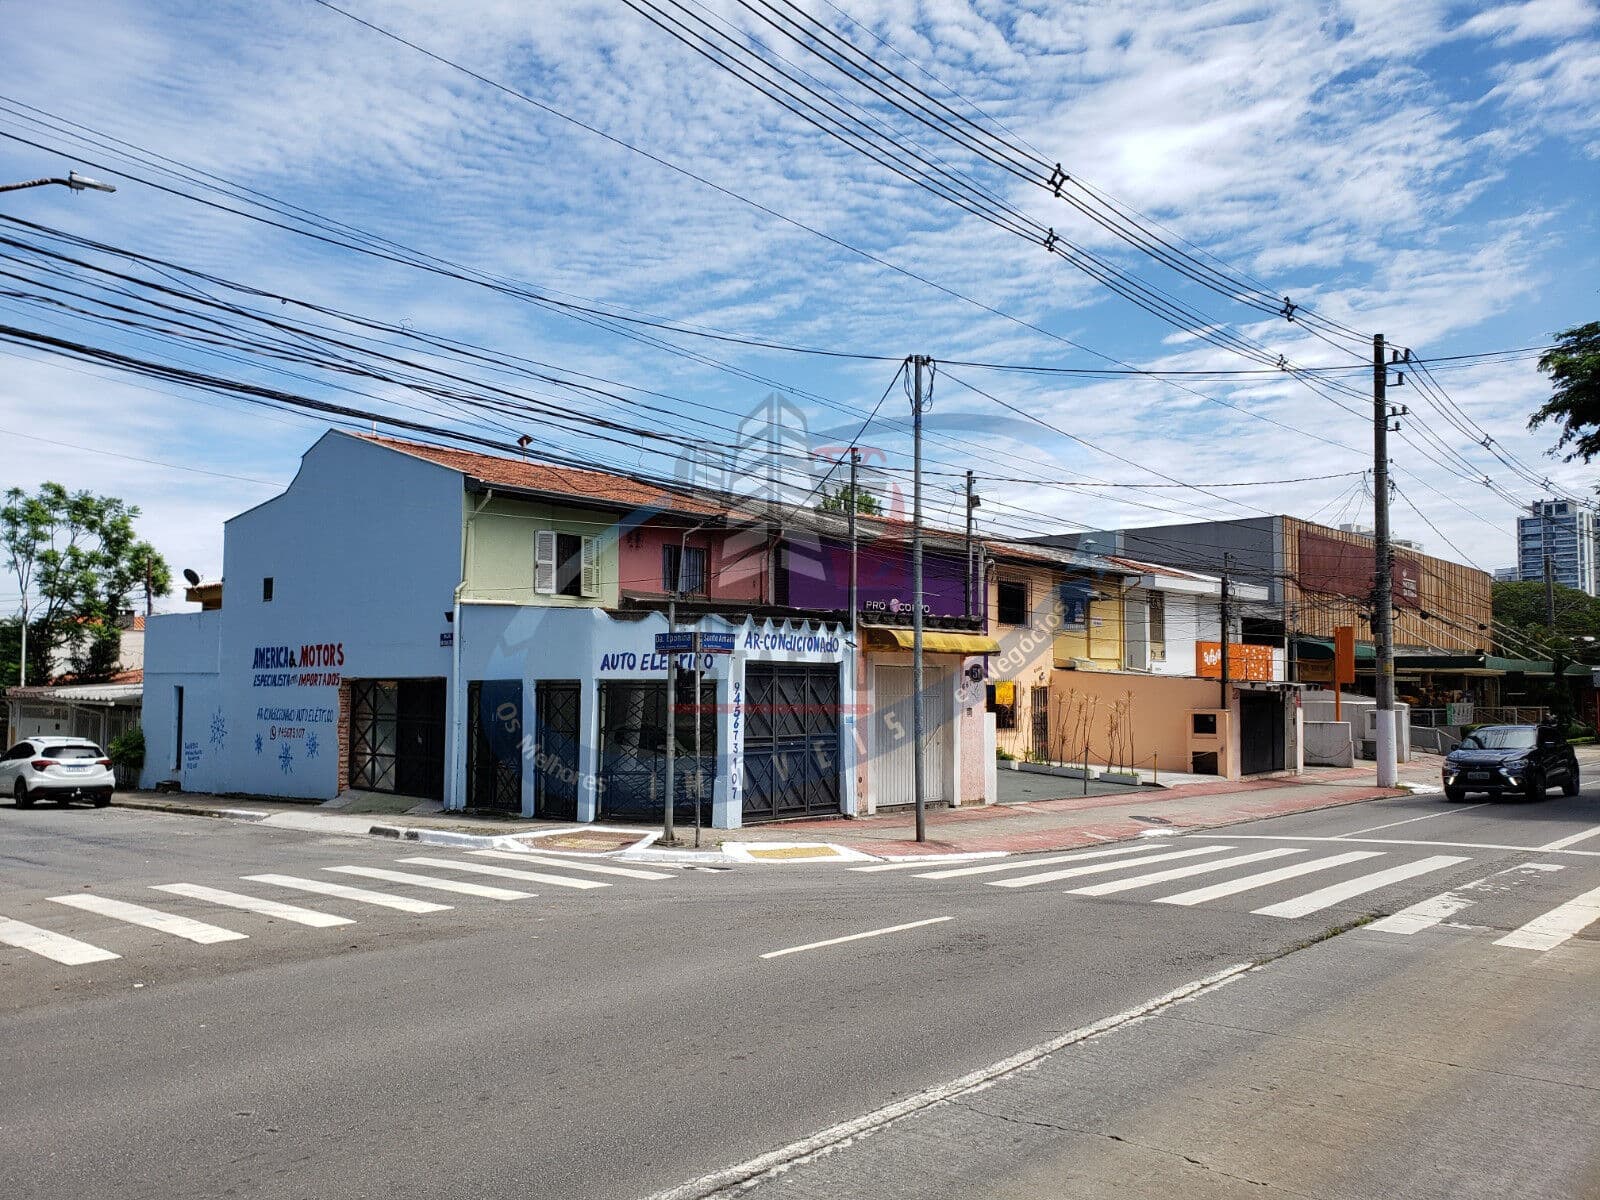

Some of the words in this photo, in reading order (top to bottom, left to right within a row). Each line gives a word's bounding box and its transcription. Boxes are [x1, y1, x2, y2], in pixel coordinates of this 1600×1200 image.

[299, 643, 344, 667] MOTORS
[601, 652, 636, 671] AUTO
[298, 673, 340, 687] IMPORTADOS
